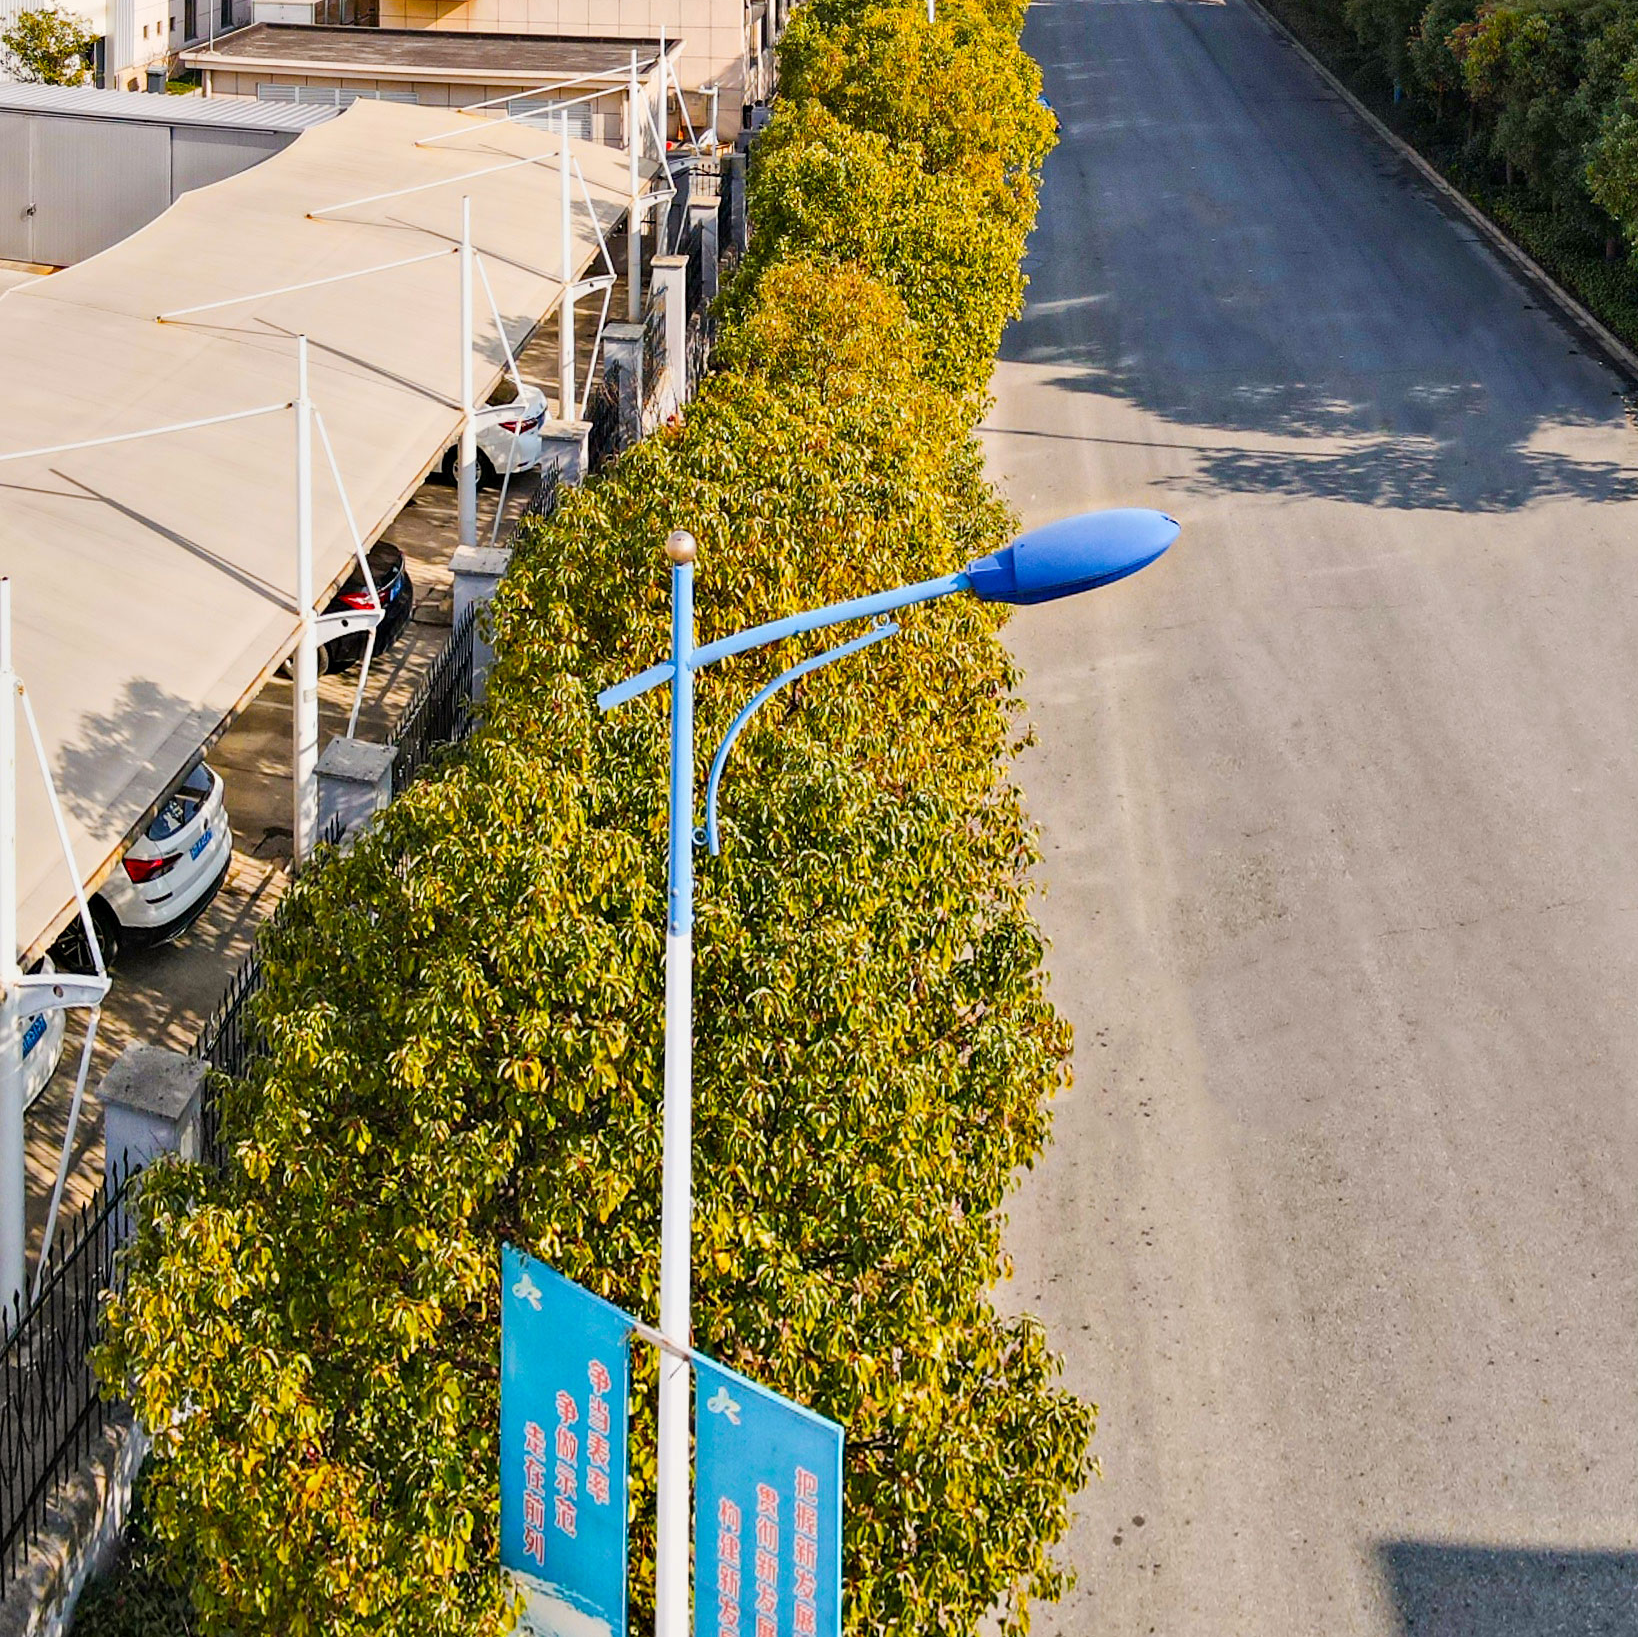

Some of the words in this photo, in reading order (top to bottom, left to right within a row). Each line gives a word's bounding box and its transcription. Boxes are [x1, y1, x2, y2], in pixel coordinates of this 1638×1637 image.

[523, 1421, 546, 1567] 走在前列
[554, 1389, 578, 1540] 争做示范
[586, 1359, 611, 1506] 争当表率
[718, 1496, 741, 1637] 构建新发
